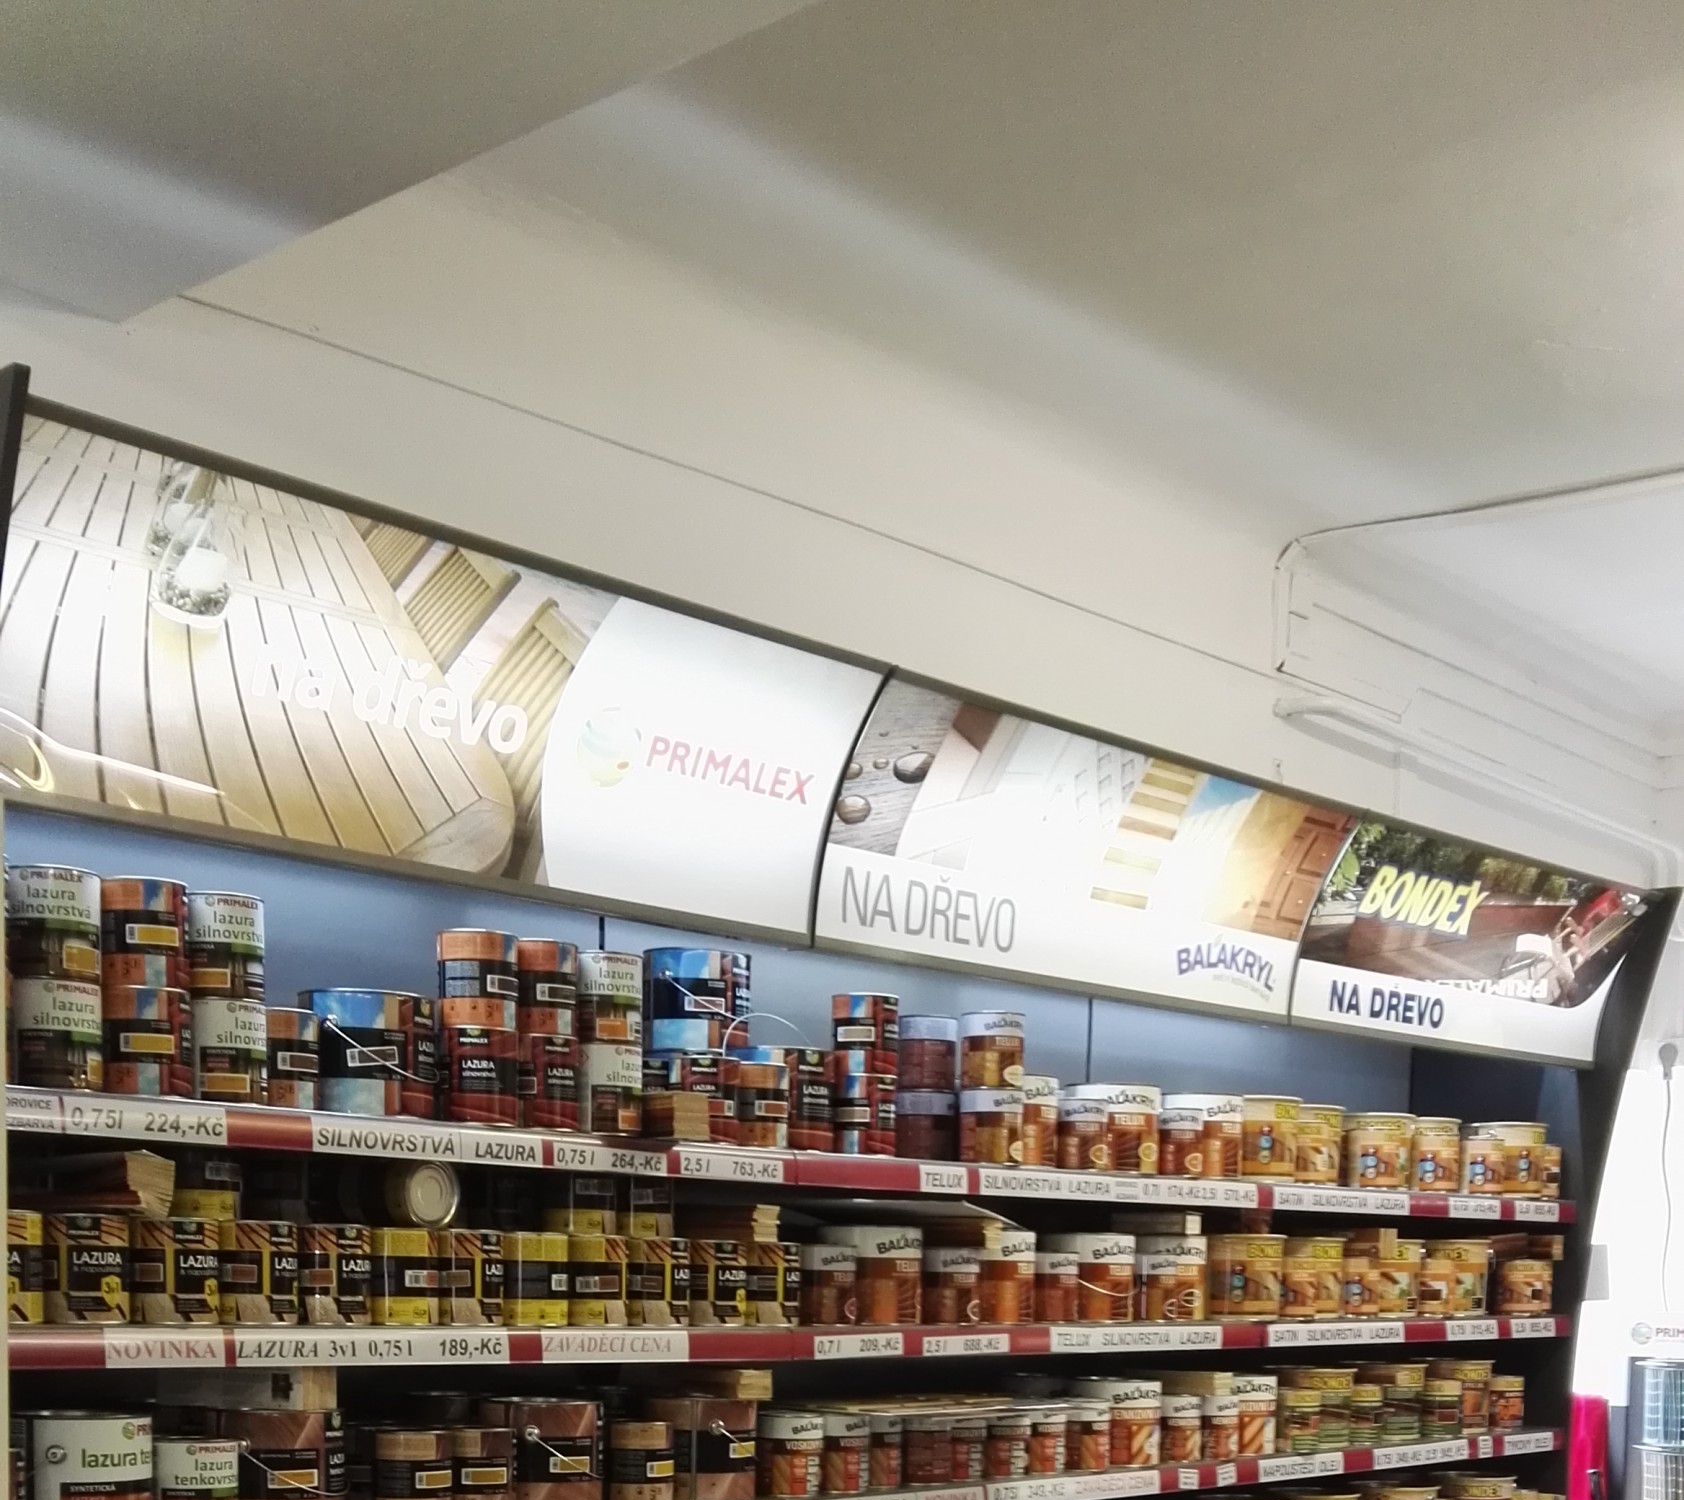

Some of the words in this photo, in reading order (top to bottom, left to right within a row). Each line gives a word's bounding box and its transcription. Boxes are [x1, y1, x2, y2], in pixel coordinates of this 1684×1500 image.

[252, 658, 336, 711] na
[352, 656, 528, 754] dřevo
[645, 735, 815, 806] PRIMALEX
[27, 884, 76, 900] lazura
[1358, 864, 1489, 936] BONDEX
[11, 902, 90, 920] silnovrstvá
[217, 898, 258, 910] PRIMALEX
[842, 866, 896, 932] NA
[904, 874, 1016, 953] DŘEVO
[213, 911, 255, 927] lazura
[599, 967, 634, 981] lazura
[1177, 942, 1274, 992] BALAKRYL
[52, 998, 96, 1014] lazura
[1329, 980, 1361, 1017] NA
[239, 1002, 266, 1014] PRIMA
[216, 1031, 266, 1044] silnovrs
[462, 1059, 495, 1070] LAZURA
[548, 1067, 574, 1078] LAZURA
[144, 1112, 224, 1137] 224,-Kč
[318, 1126, 456, 1156] SILNOVRSTVÁ
[475, 1141, 537, 1163] LAZURA
[612, 1152, 662, 1172] 264,-Kč
[732, 1160, 778, 1179] 763,-Kč
[925, 1172, 964, 1188] TELUX
[1069, 1180, 1110, 1196] LAZURA
[73, 1252, 122, 1265] LAZURA
[180, 1256, 218, 1268] LAZURA
[342, 1260, 371, 1272] LAZUR
[719, 1270, 746, 1282] LAZUR
[1056, 1332, 1091, 1347] TELUX
[1179, 1330, 1219, 1345] LAZURA
[1656, 1328, 1684, 1337] PRIM
[107, 1341, 217, 1360] NOVINKA
[237, 1341, 319, 1359] LAZURA
[329, 1341, 357, 1357] 3v1
[439, 1338, 501, 1357] 189,-Kč
[544, 1334, 626, 1354] ZAVÁDĚCÍ
[630, 1337, 672, 1354] CENA
[81, 1449, 138, 1469] lazura
[195, 1458, 233, 1471] lazura
